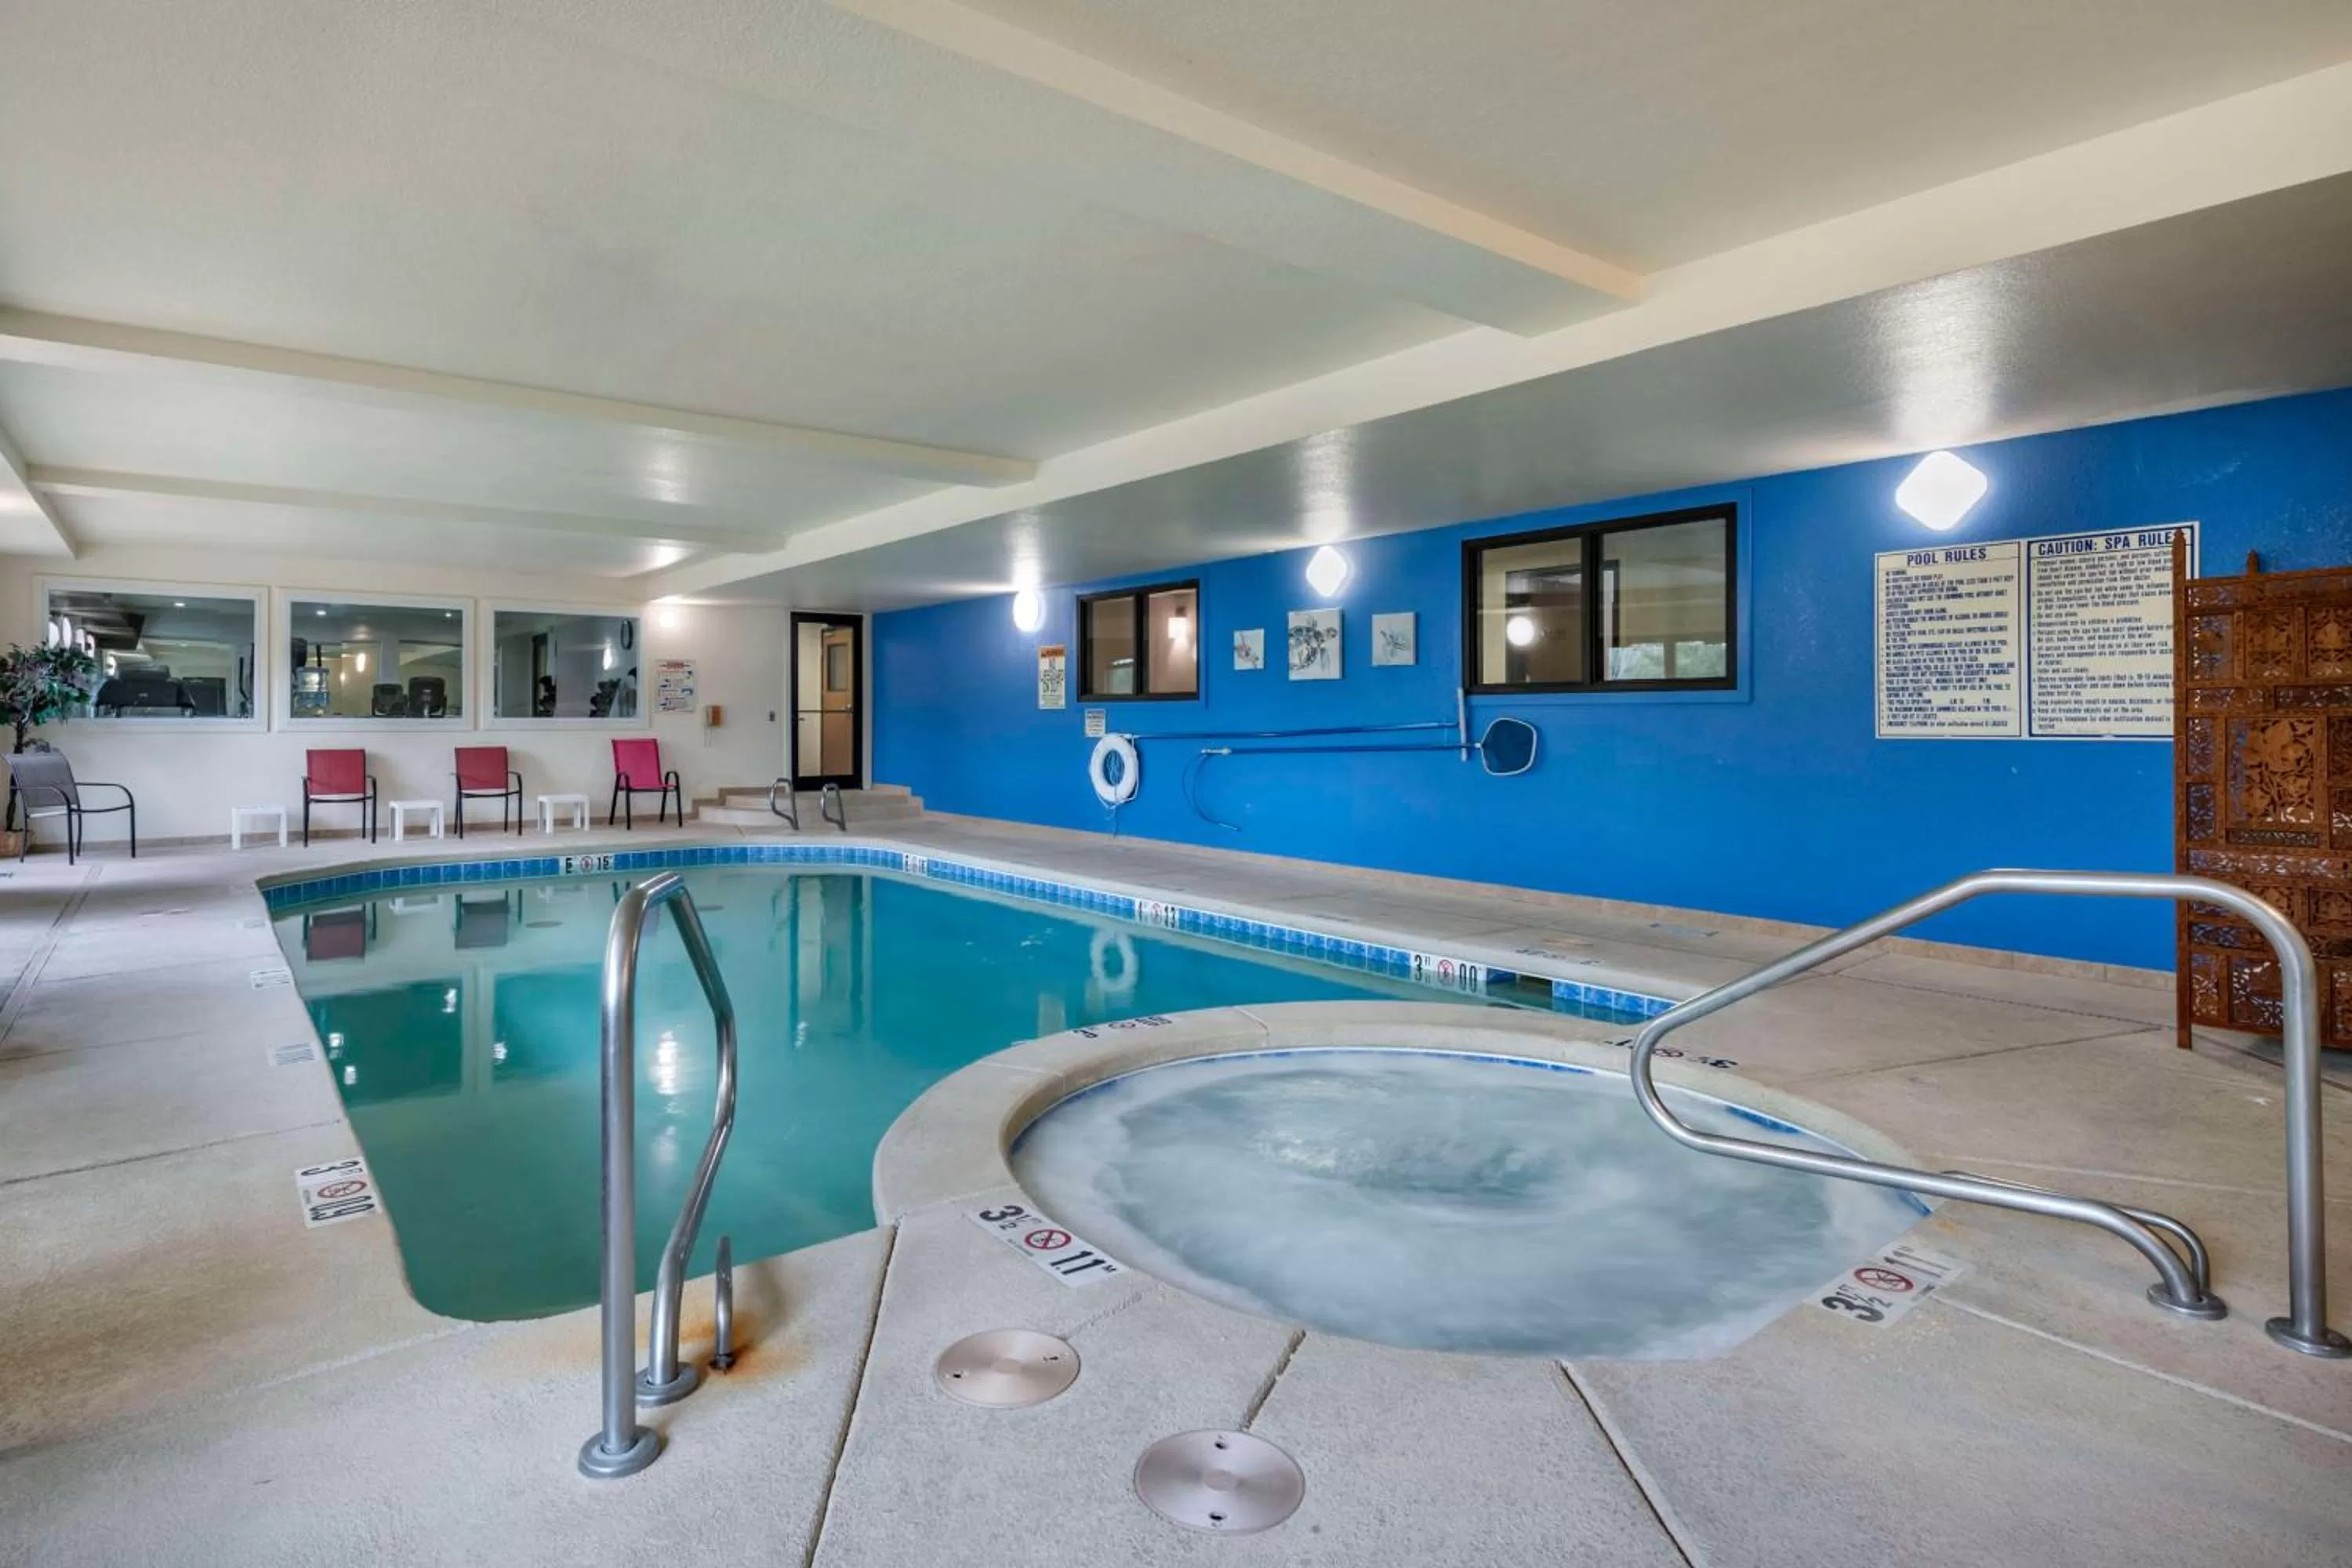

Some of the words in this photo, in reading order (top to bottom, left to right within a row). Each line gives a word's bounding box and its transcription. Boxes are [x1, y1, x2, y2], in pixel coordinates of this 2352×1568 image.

[2038, 539, 2098, 556] CAUTION:
[2105, 535, 2131, 550] SPA
[2138, 531, 2172, 546] RULE
[1907, 552, 1939, 566] POOL
[1944, 548, 1987, 562] RULES
